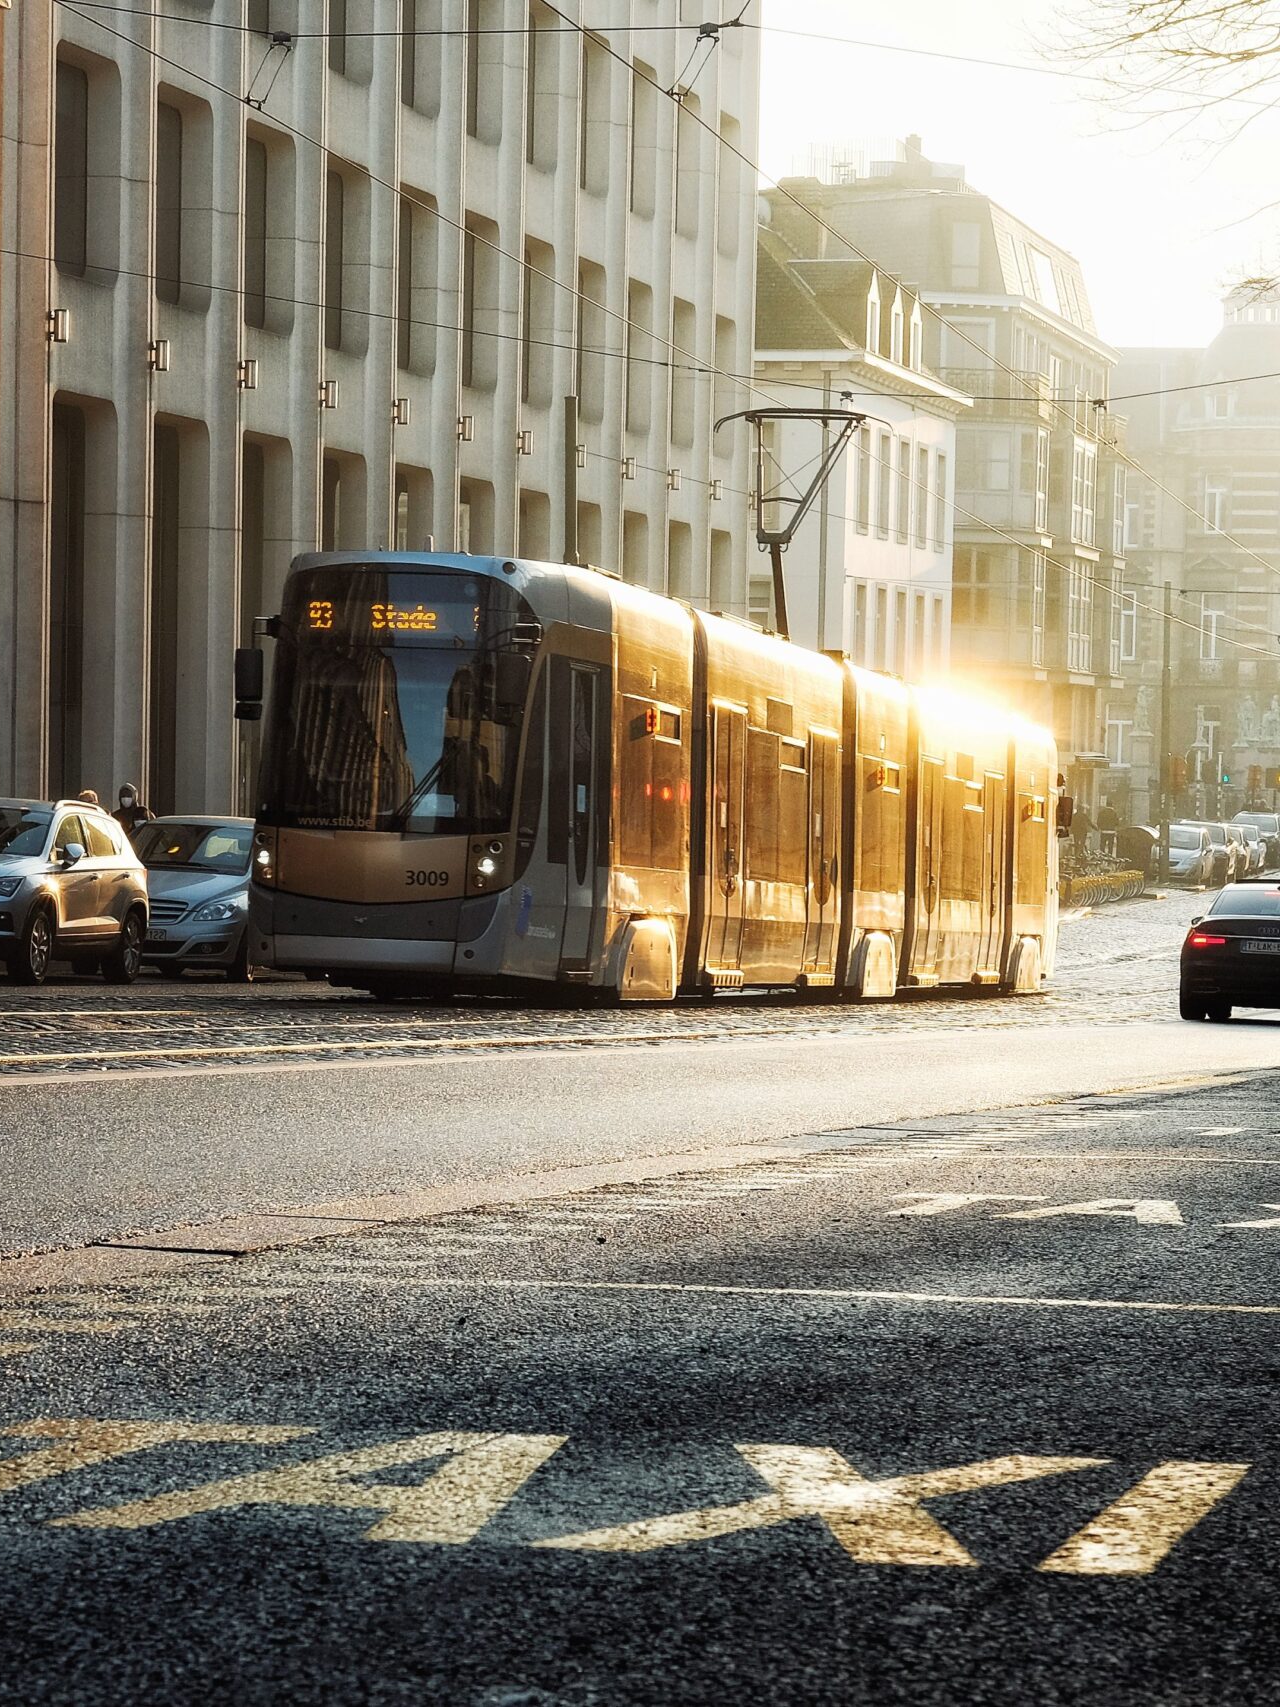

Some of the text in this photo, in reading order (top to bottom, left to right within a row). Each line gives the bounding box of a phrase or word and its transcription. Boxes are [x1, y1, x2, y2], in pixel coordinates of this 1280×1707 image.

[309, 601, 437, 629] 93 Stade
[297, 814, 371, 829] www.stib.be
[405, 870, 450, 887] 3009
